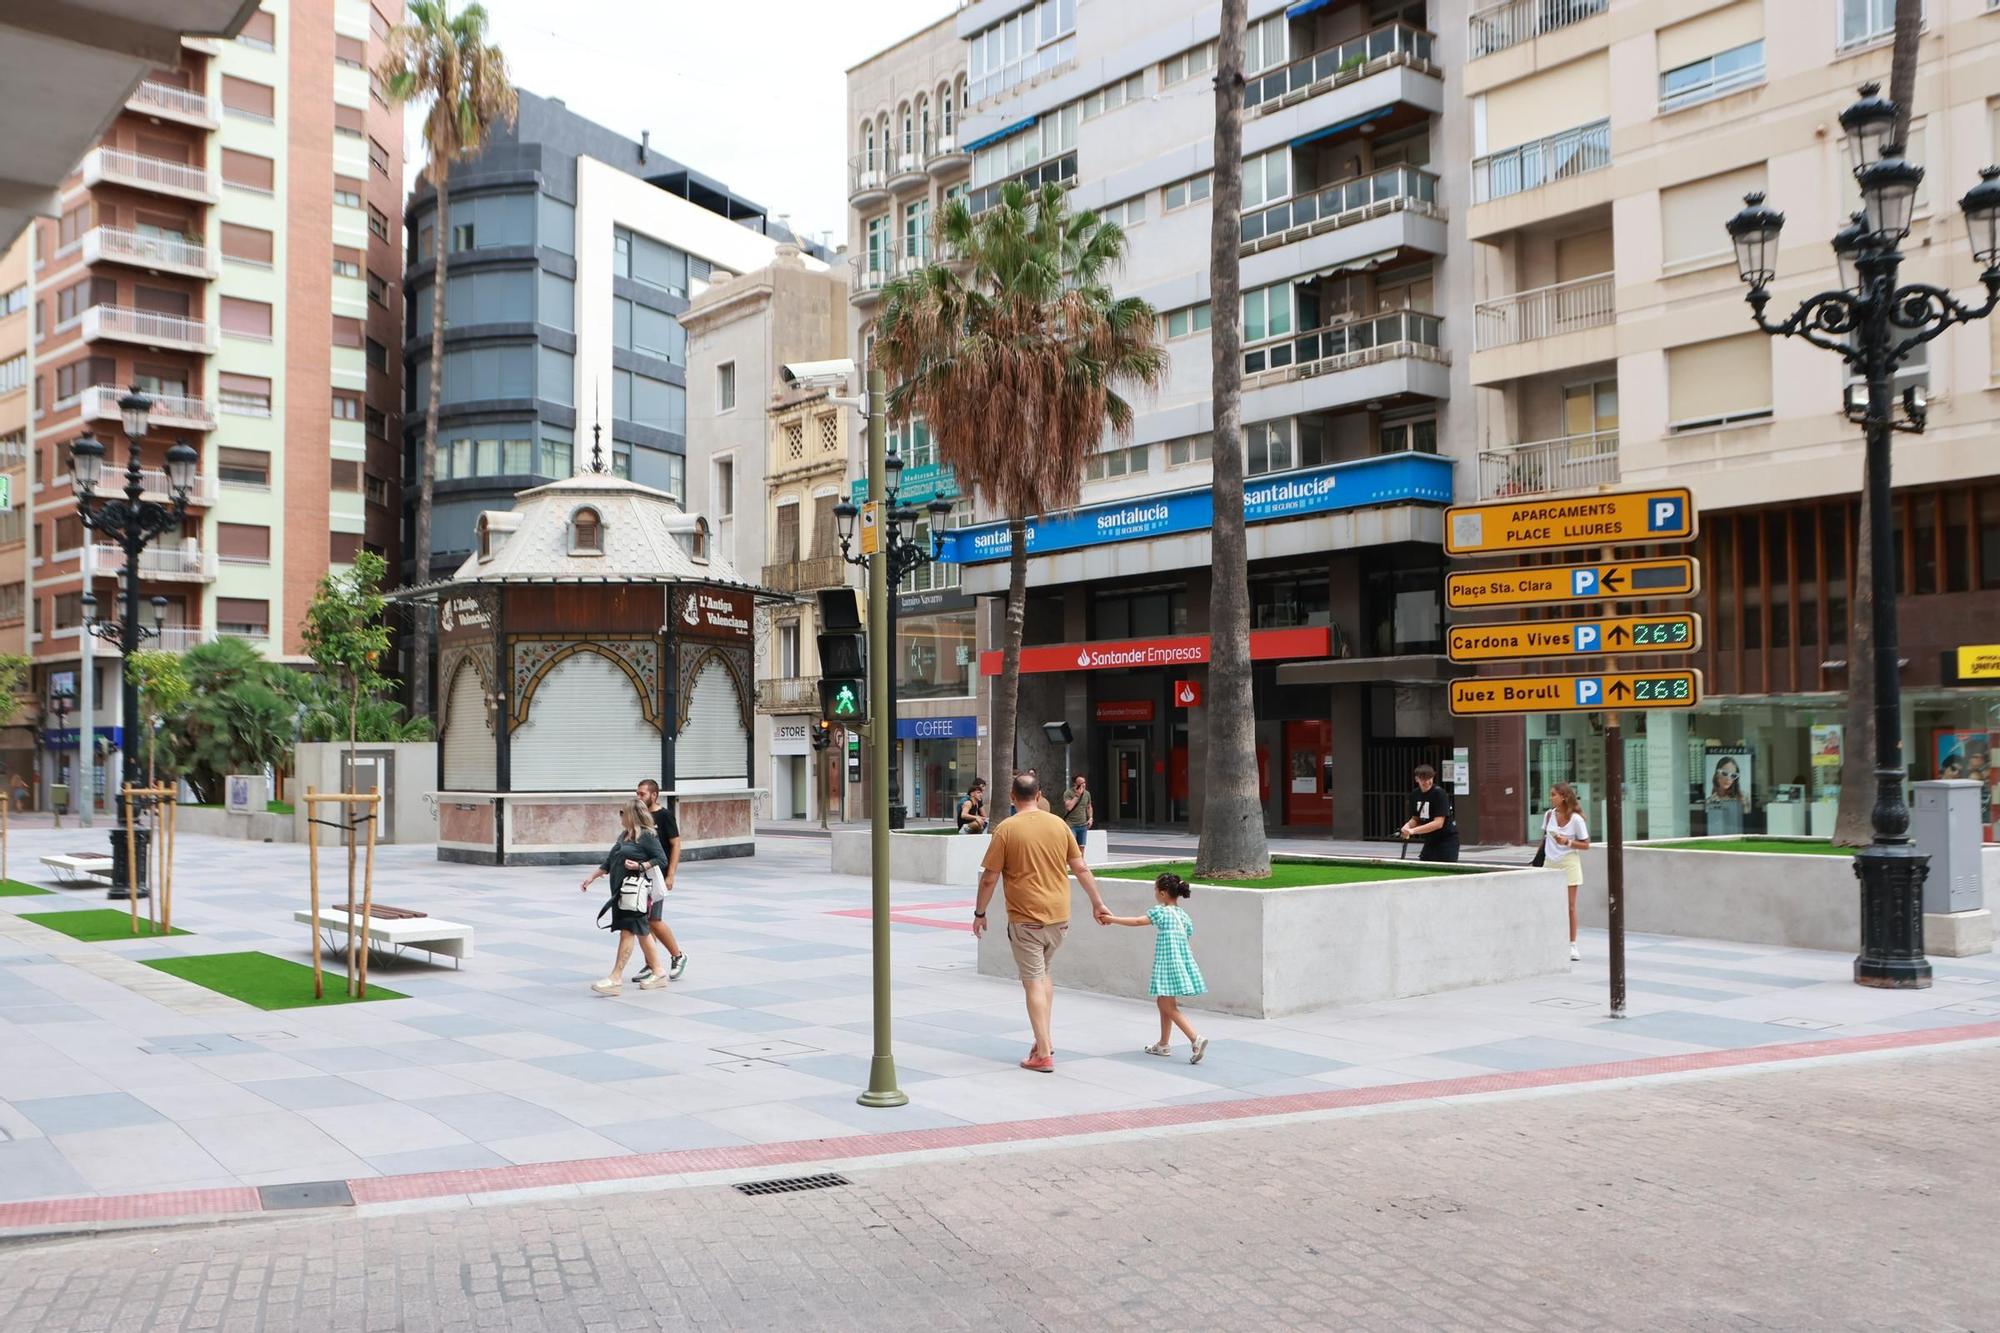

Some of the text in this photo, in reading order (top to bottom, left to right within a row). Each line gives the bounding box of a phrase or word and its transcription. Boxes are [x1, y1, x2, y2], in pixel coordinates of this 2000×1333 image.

[1242, 478, 1330, 506] santalucía
[1097, 504, 1169, 529] santalucía
[1511, 502, 1616, 523] APARCAMENTS
[1506, 521, 1623, 542] PLACE LLIURES
[1452, 583, 1487, 599] Plaça
[1490, 581, 1515, 595] Sta.
[1518, 579, 1553, 592] Clara
[699, 595, 733, 614] L'Antiga
[706, 612, 749, 629] Valenciana
[1452, 635, 1519, 650] Cardona
[1527, 631, 1570, 647] Vives
[1634, 622, 1688, 645] 269
[1091, 646, 1202, 666] Santander Empresas
[1456, 688, 1496, 703] Juez
[1503, 684, 1561, 700] Borull
[1634, 679, 1689, 700] 268
[780, 726, 806, 737] STORE
[915, 720, 953, 736] COFFEE
